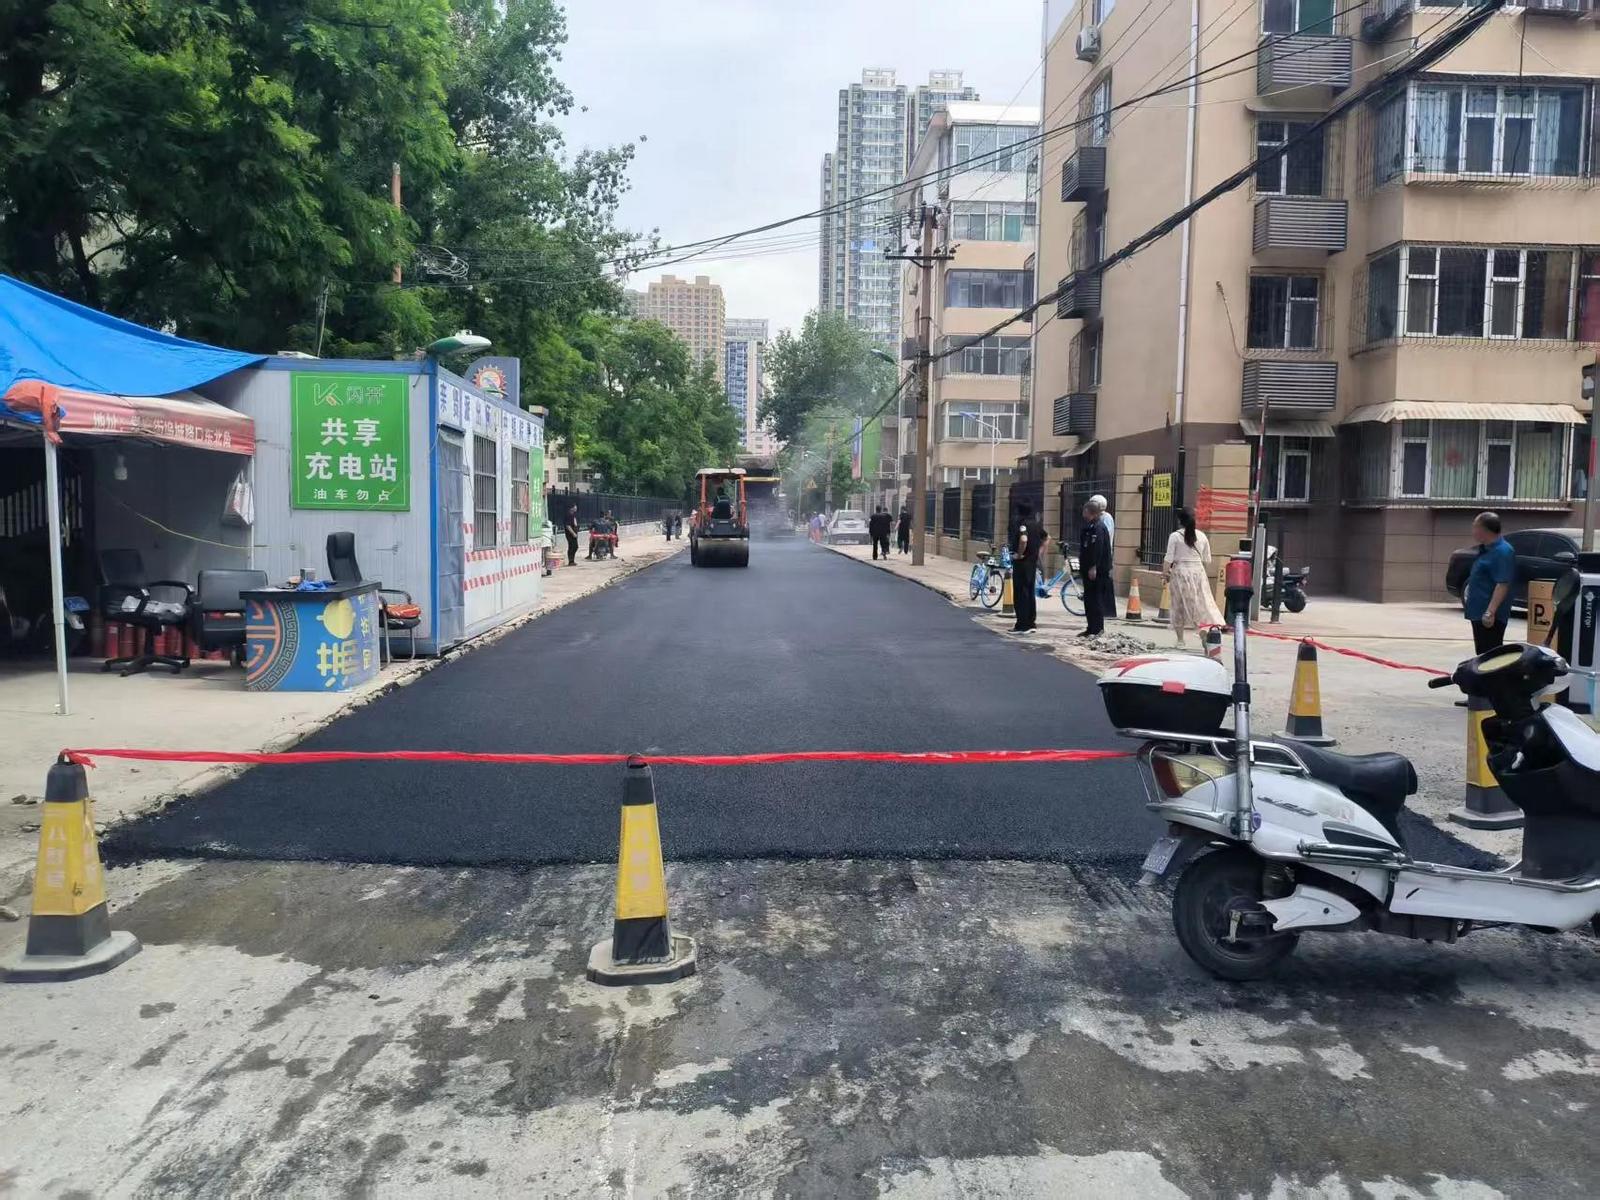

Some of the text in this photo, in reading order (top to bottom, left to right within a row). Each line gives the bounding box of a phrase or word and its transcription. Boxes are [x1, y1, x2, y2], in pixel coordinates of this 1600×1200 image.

[321, 418, 381, 447] 共享
[305, 452, 397, 482] 充电站
[313, 488, 390, 502] 油车勿占
